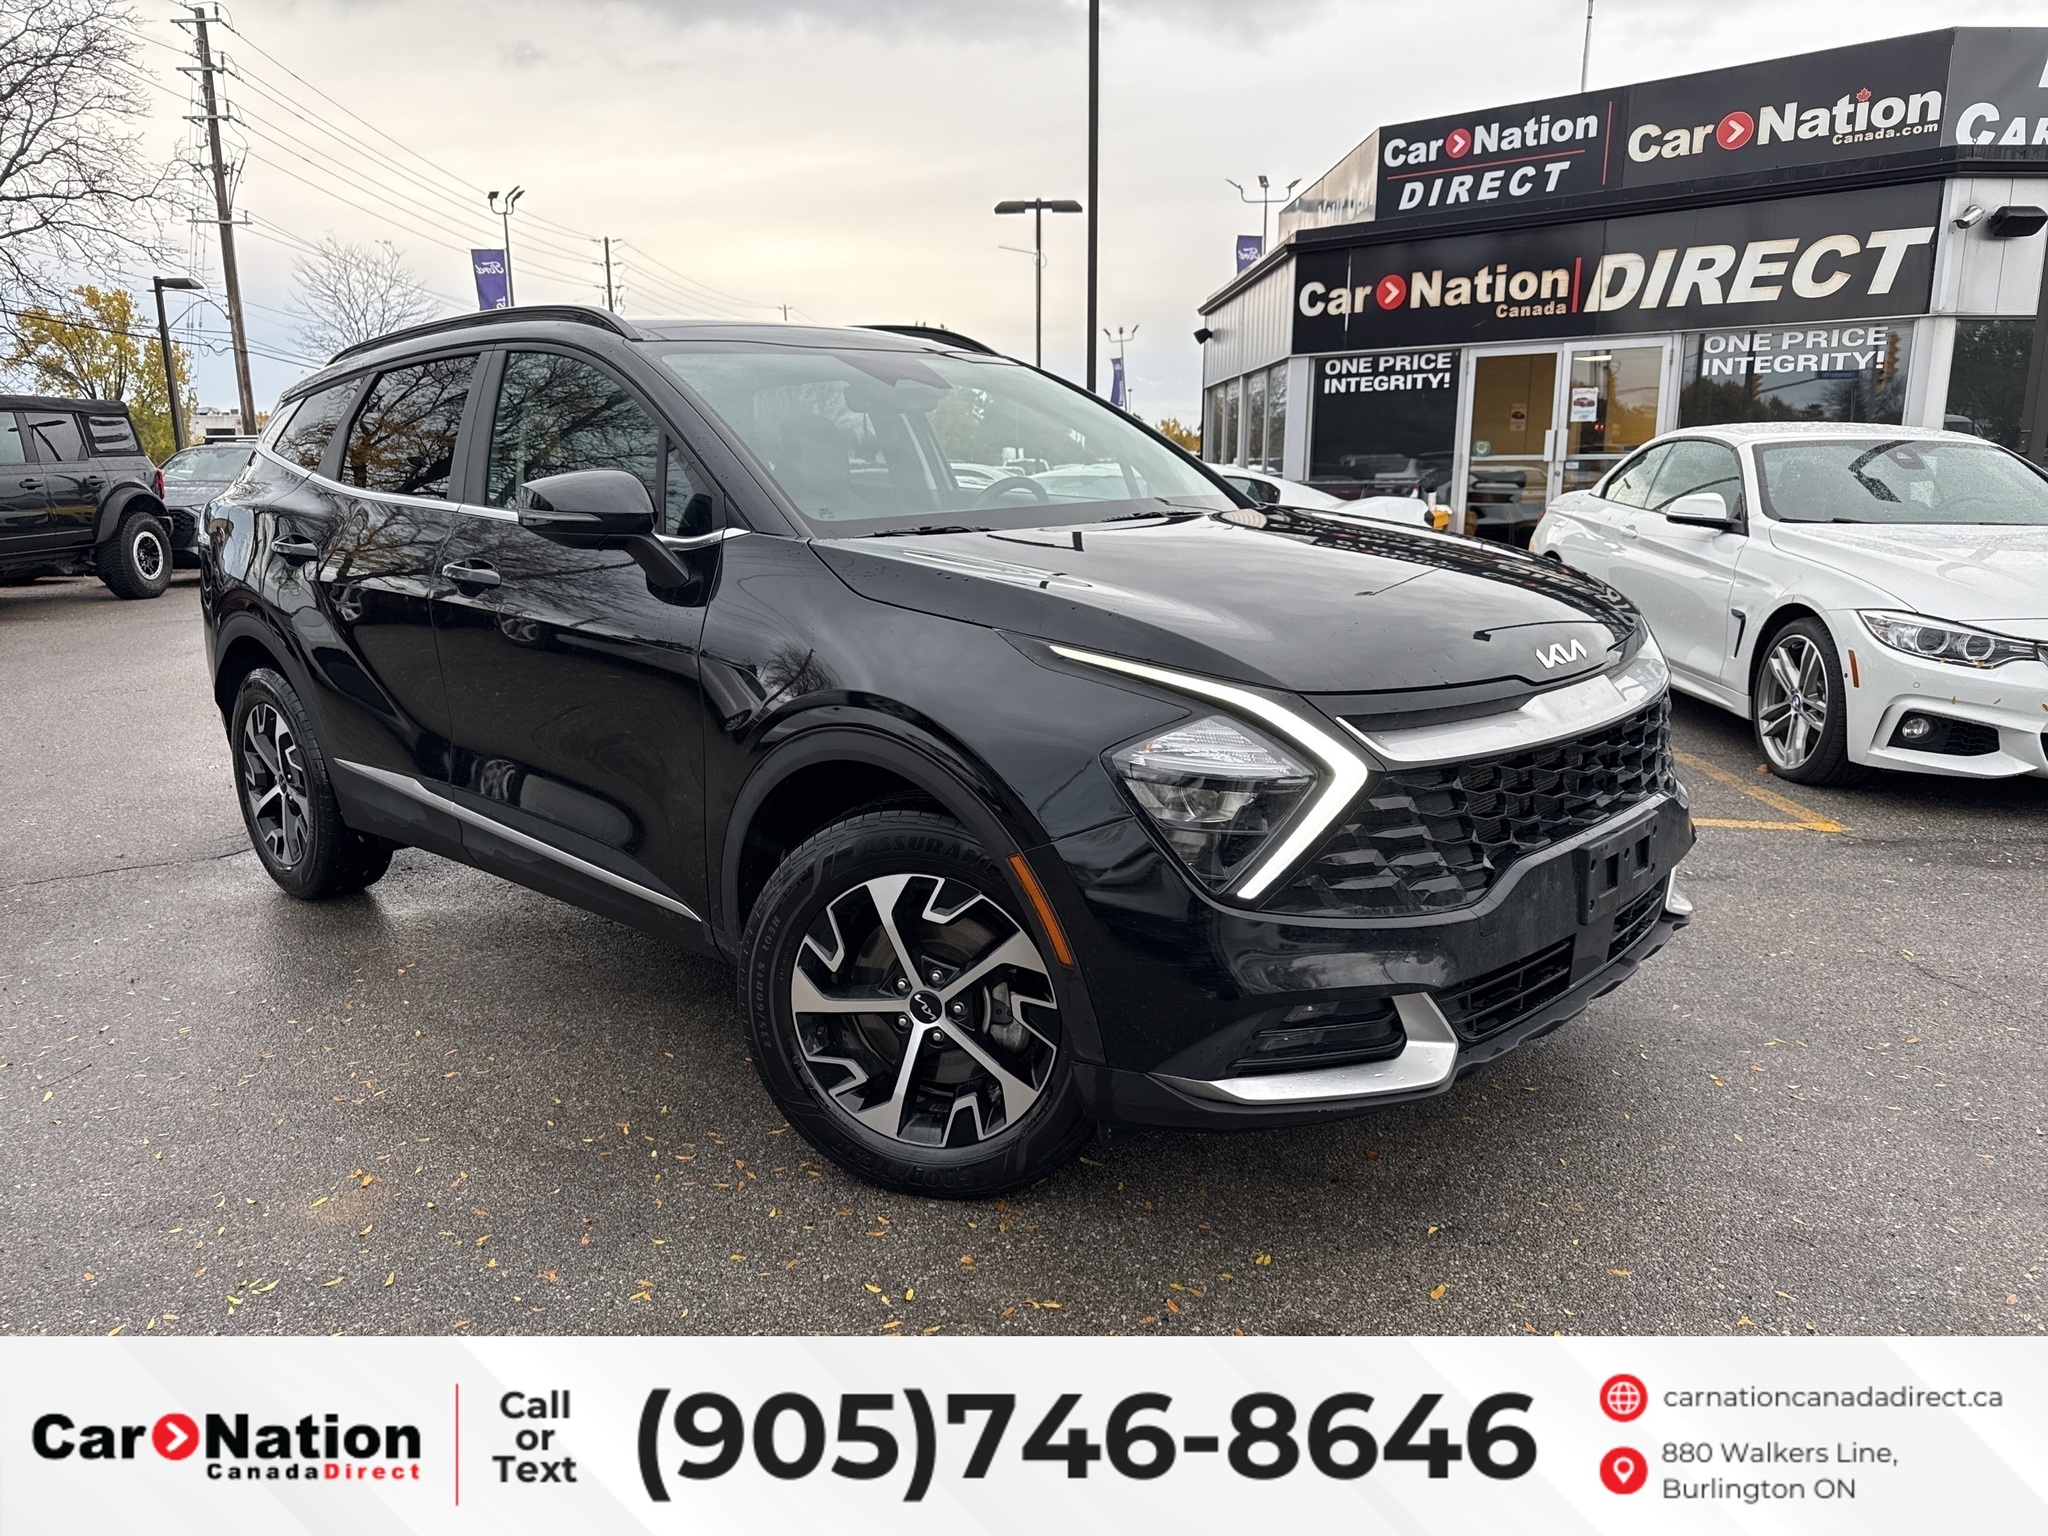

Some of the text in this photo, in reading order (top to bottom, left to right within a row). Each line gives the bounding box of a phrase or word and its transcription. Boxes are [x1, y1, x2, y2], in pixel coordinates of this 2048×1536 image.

[1383, 114, 1599, 168] Car Nation
[1627, 89, 1943, 163] Car Nation
[1831, 122, 1938, 146] Canada.com
[1398, 161, 1572, 211] DIRECT
[1583, 226, 1936, 313] DIRECT
[1298, 263, 1571, 317] Car Nation
[1495, 300, 1567, 319] Canada
[1704, 326, 1890, 354] ONE PRICE
[1324, 352, 1453, 376] ONE PRICE
[1702, 350, 1886, 377] INTEGRITY!
[1323, 371, 1452, 395] INTEGRITY!
[1535, 638, 1588, 670] KIA
[863, 835, 1006, 887] ASSURANC
